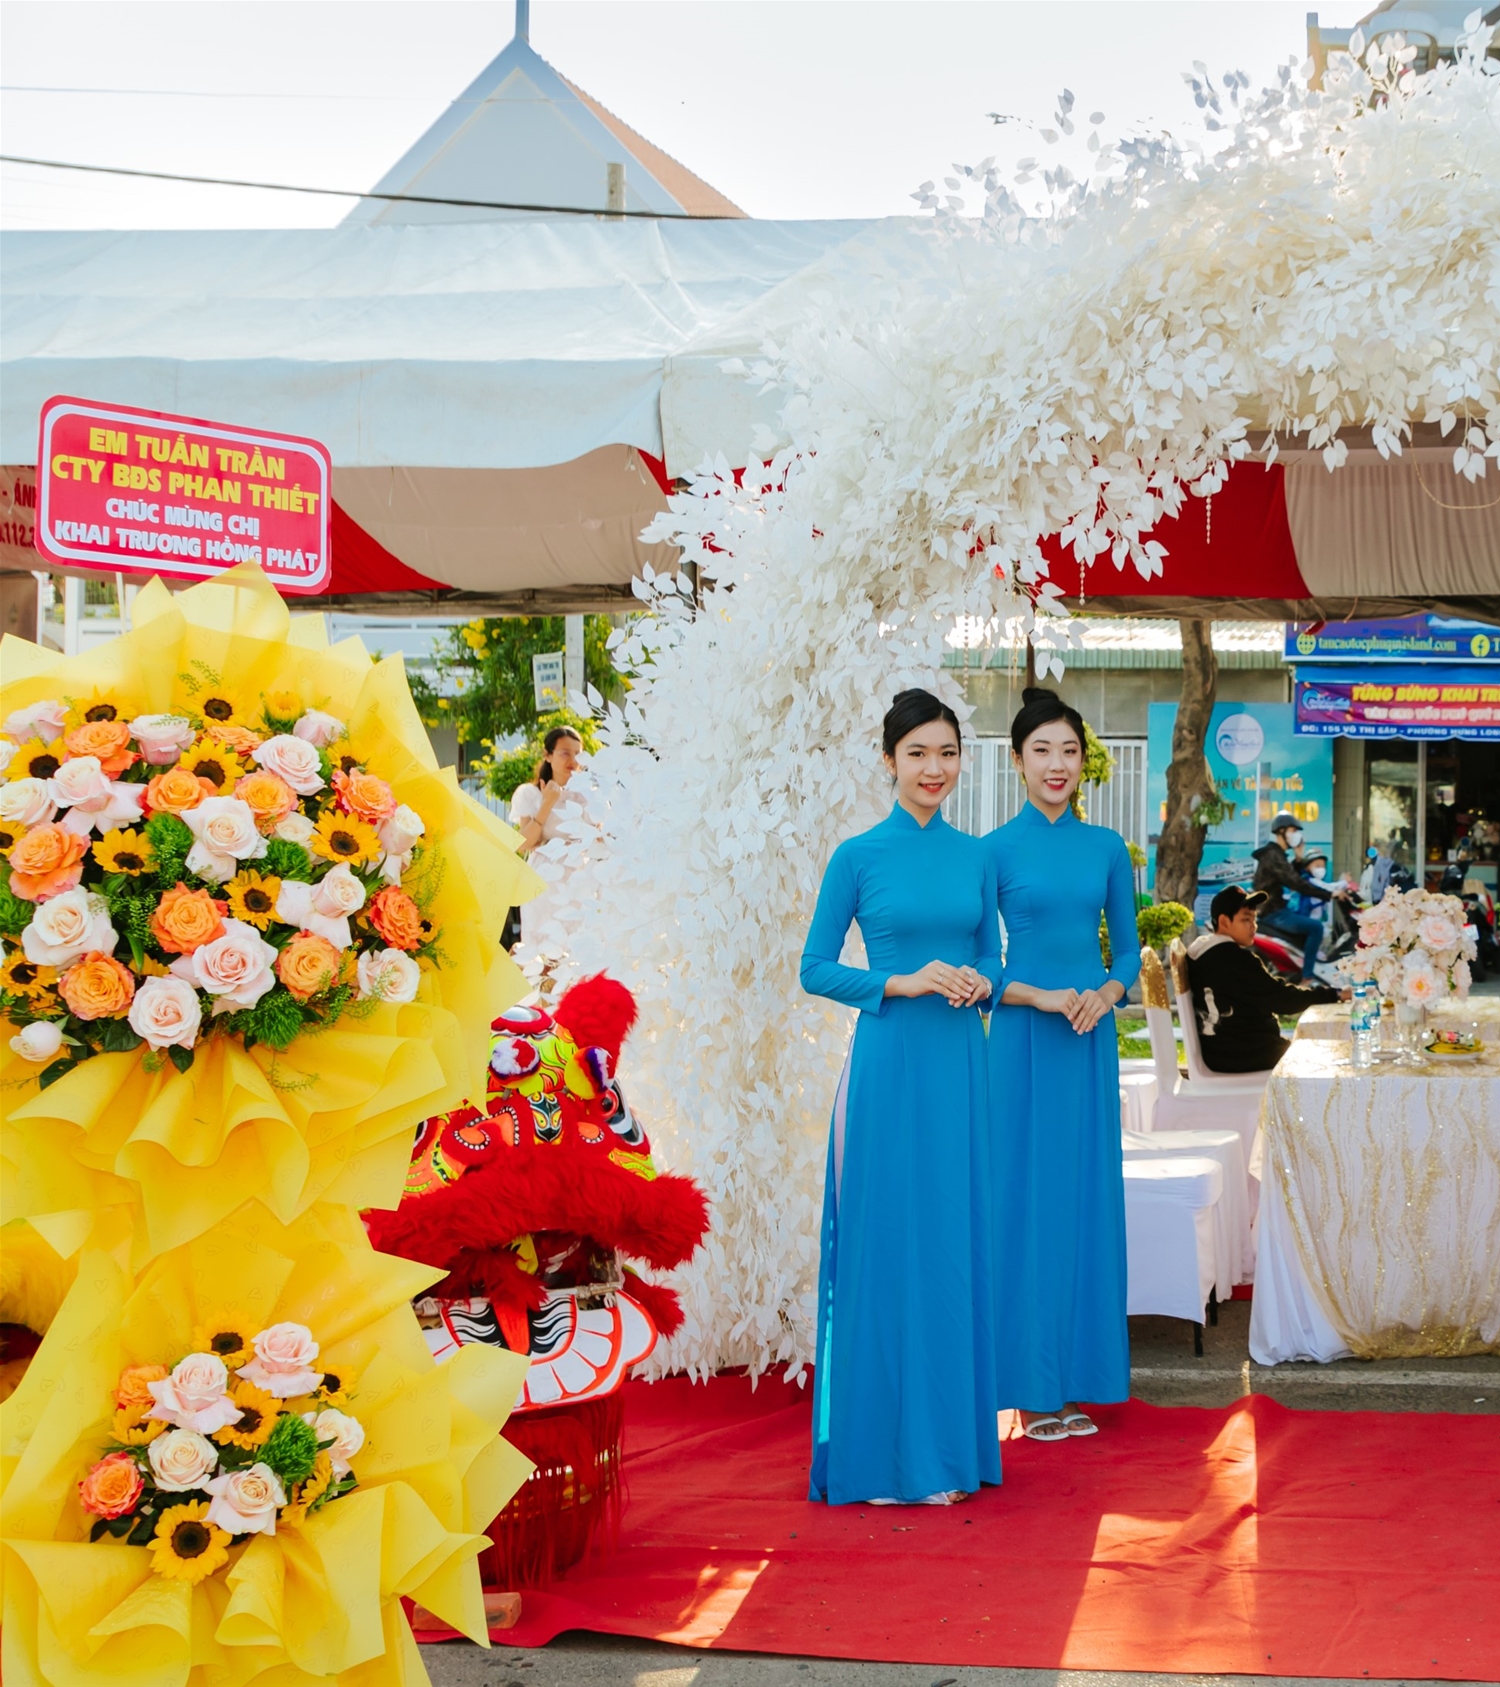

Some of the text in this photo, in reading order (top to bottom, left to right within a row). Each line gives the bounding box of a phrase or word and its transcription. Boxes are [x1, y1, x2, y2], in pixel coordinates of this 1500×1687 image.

[89, 427, 285, 480] EM TUẤN TRẦN
[51, 454, 319, 515] CTY BĐS PHAN THIẾT
[54, 519, 318, 572] KHAI TRƯƠNG HỒNG PHÁT
[106, 498, 260, 540] CHÚC MỪNG CHỊ
[1440, 687, 1479, 702] KHAI
